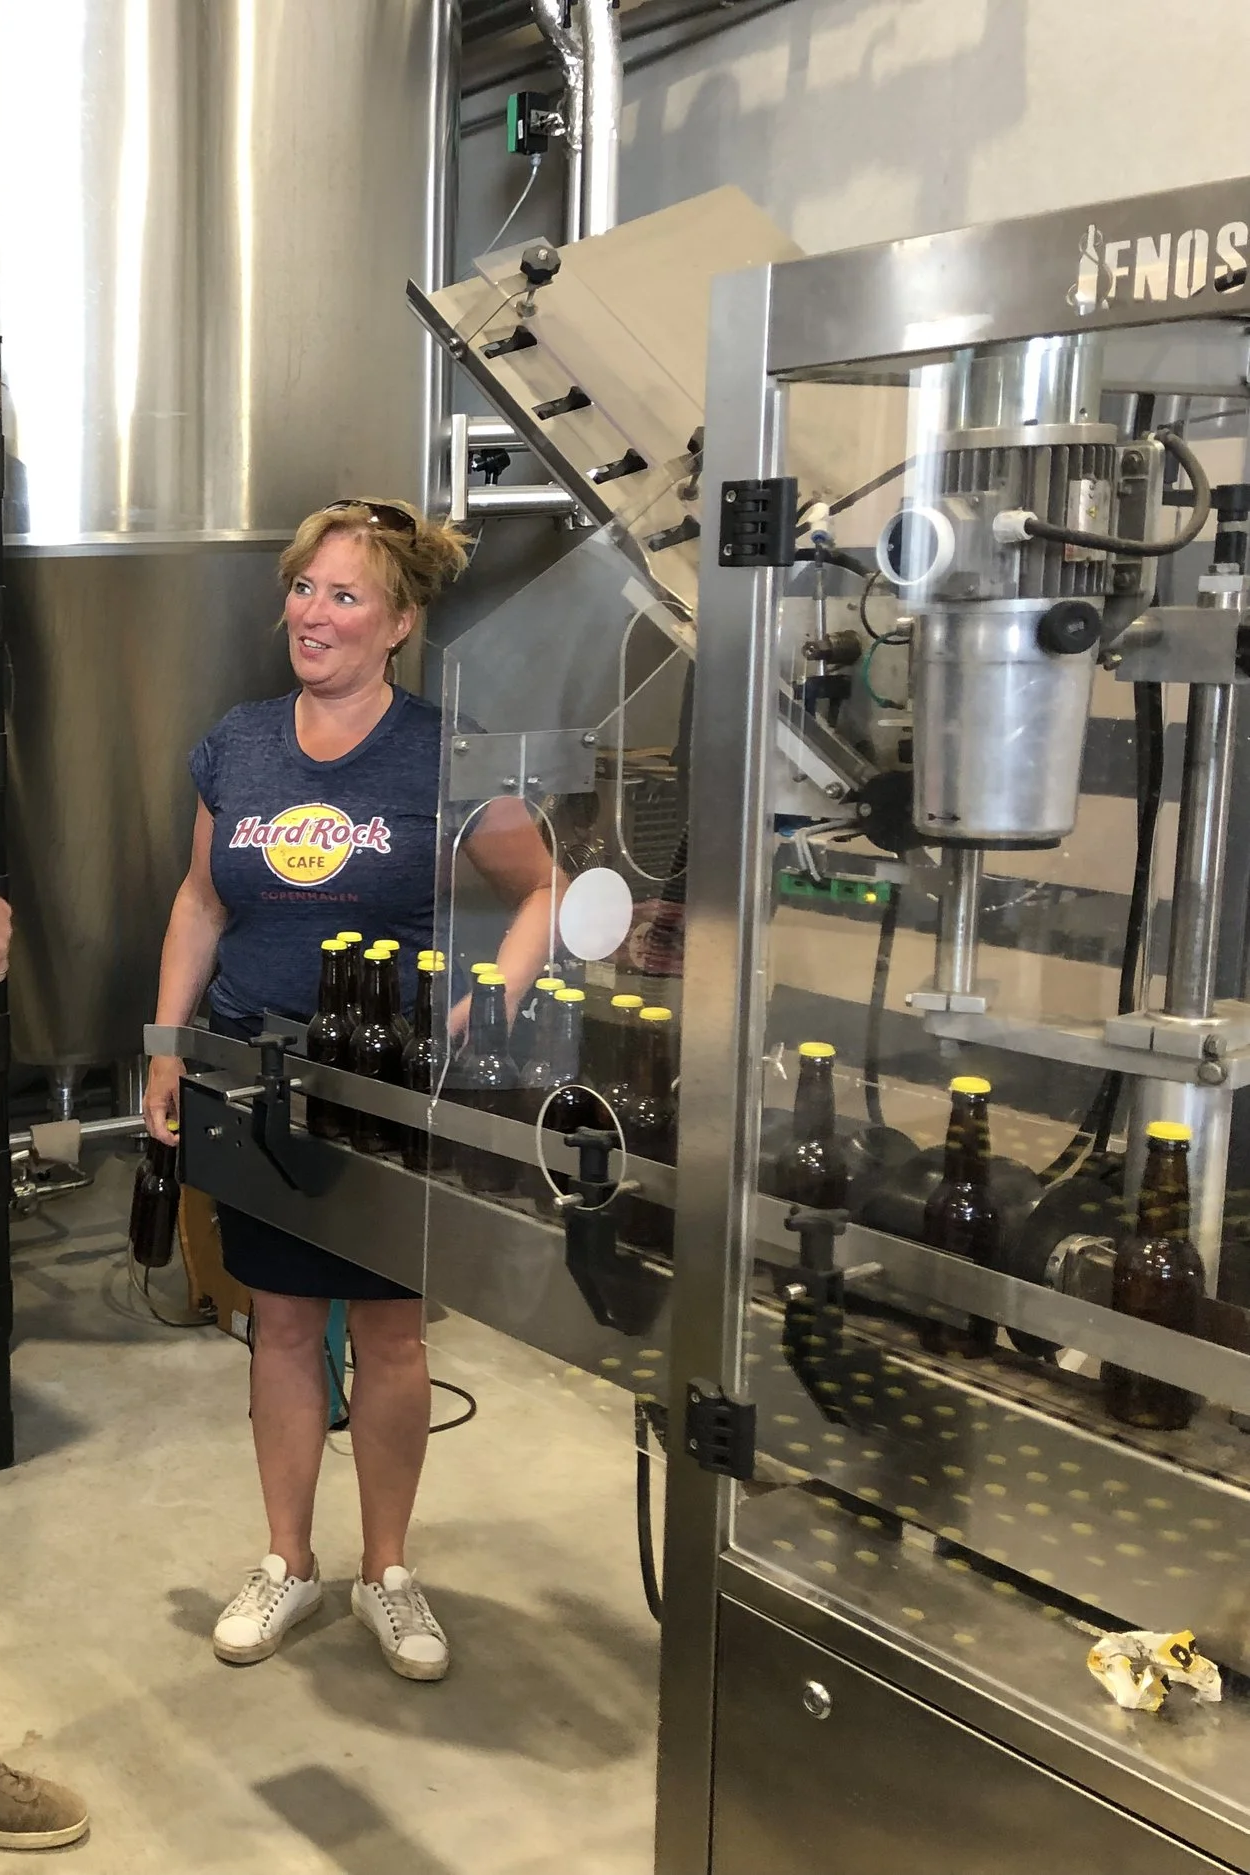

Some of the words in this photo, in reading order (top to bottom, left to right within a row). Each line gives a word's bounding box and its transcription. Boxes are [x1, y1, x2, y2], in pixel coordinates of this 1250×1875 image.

[229, 816, 309, 848] Hard
[309, 816, 391, 853] Rock
[287, 856, 325, 868] CAFE
[261, 891, 359, 902] COPENHAGEN
